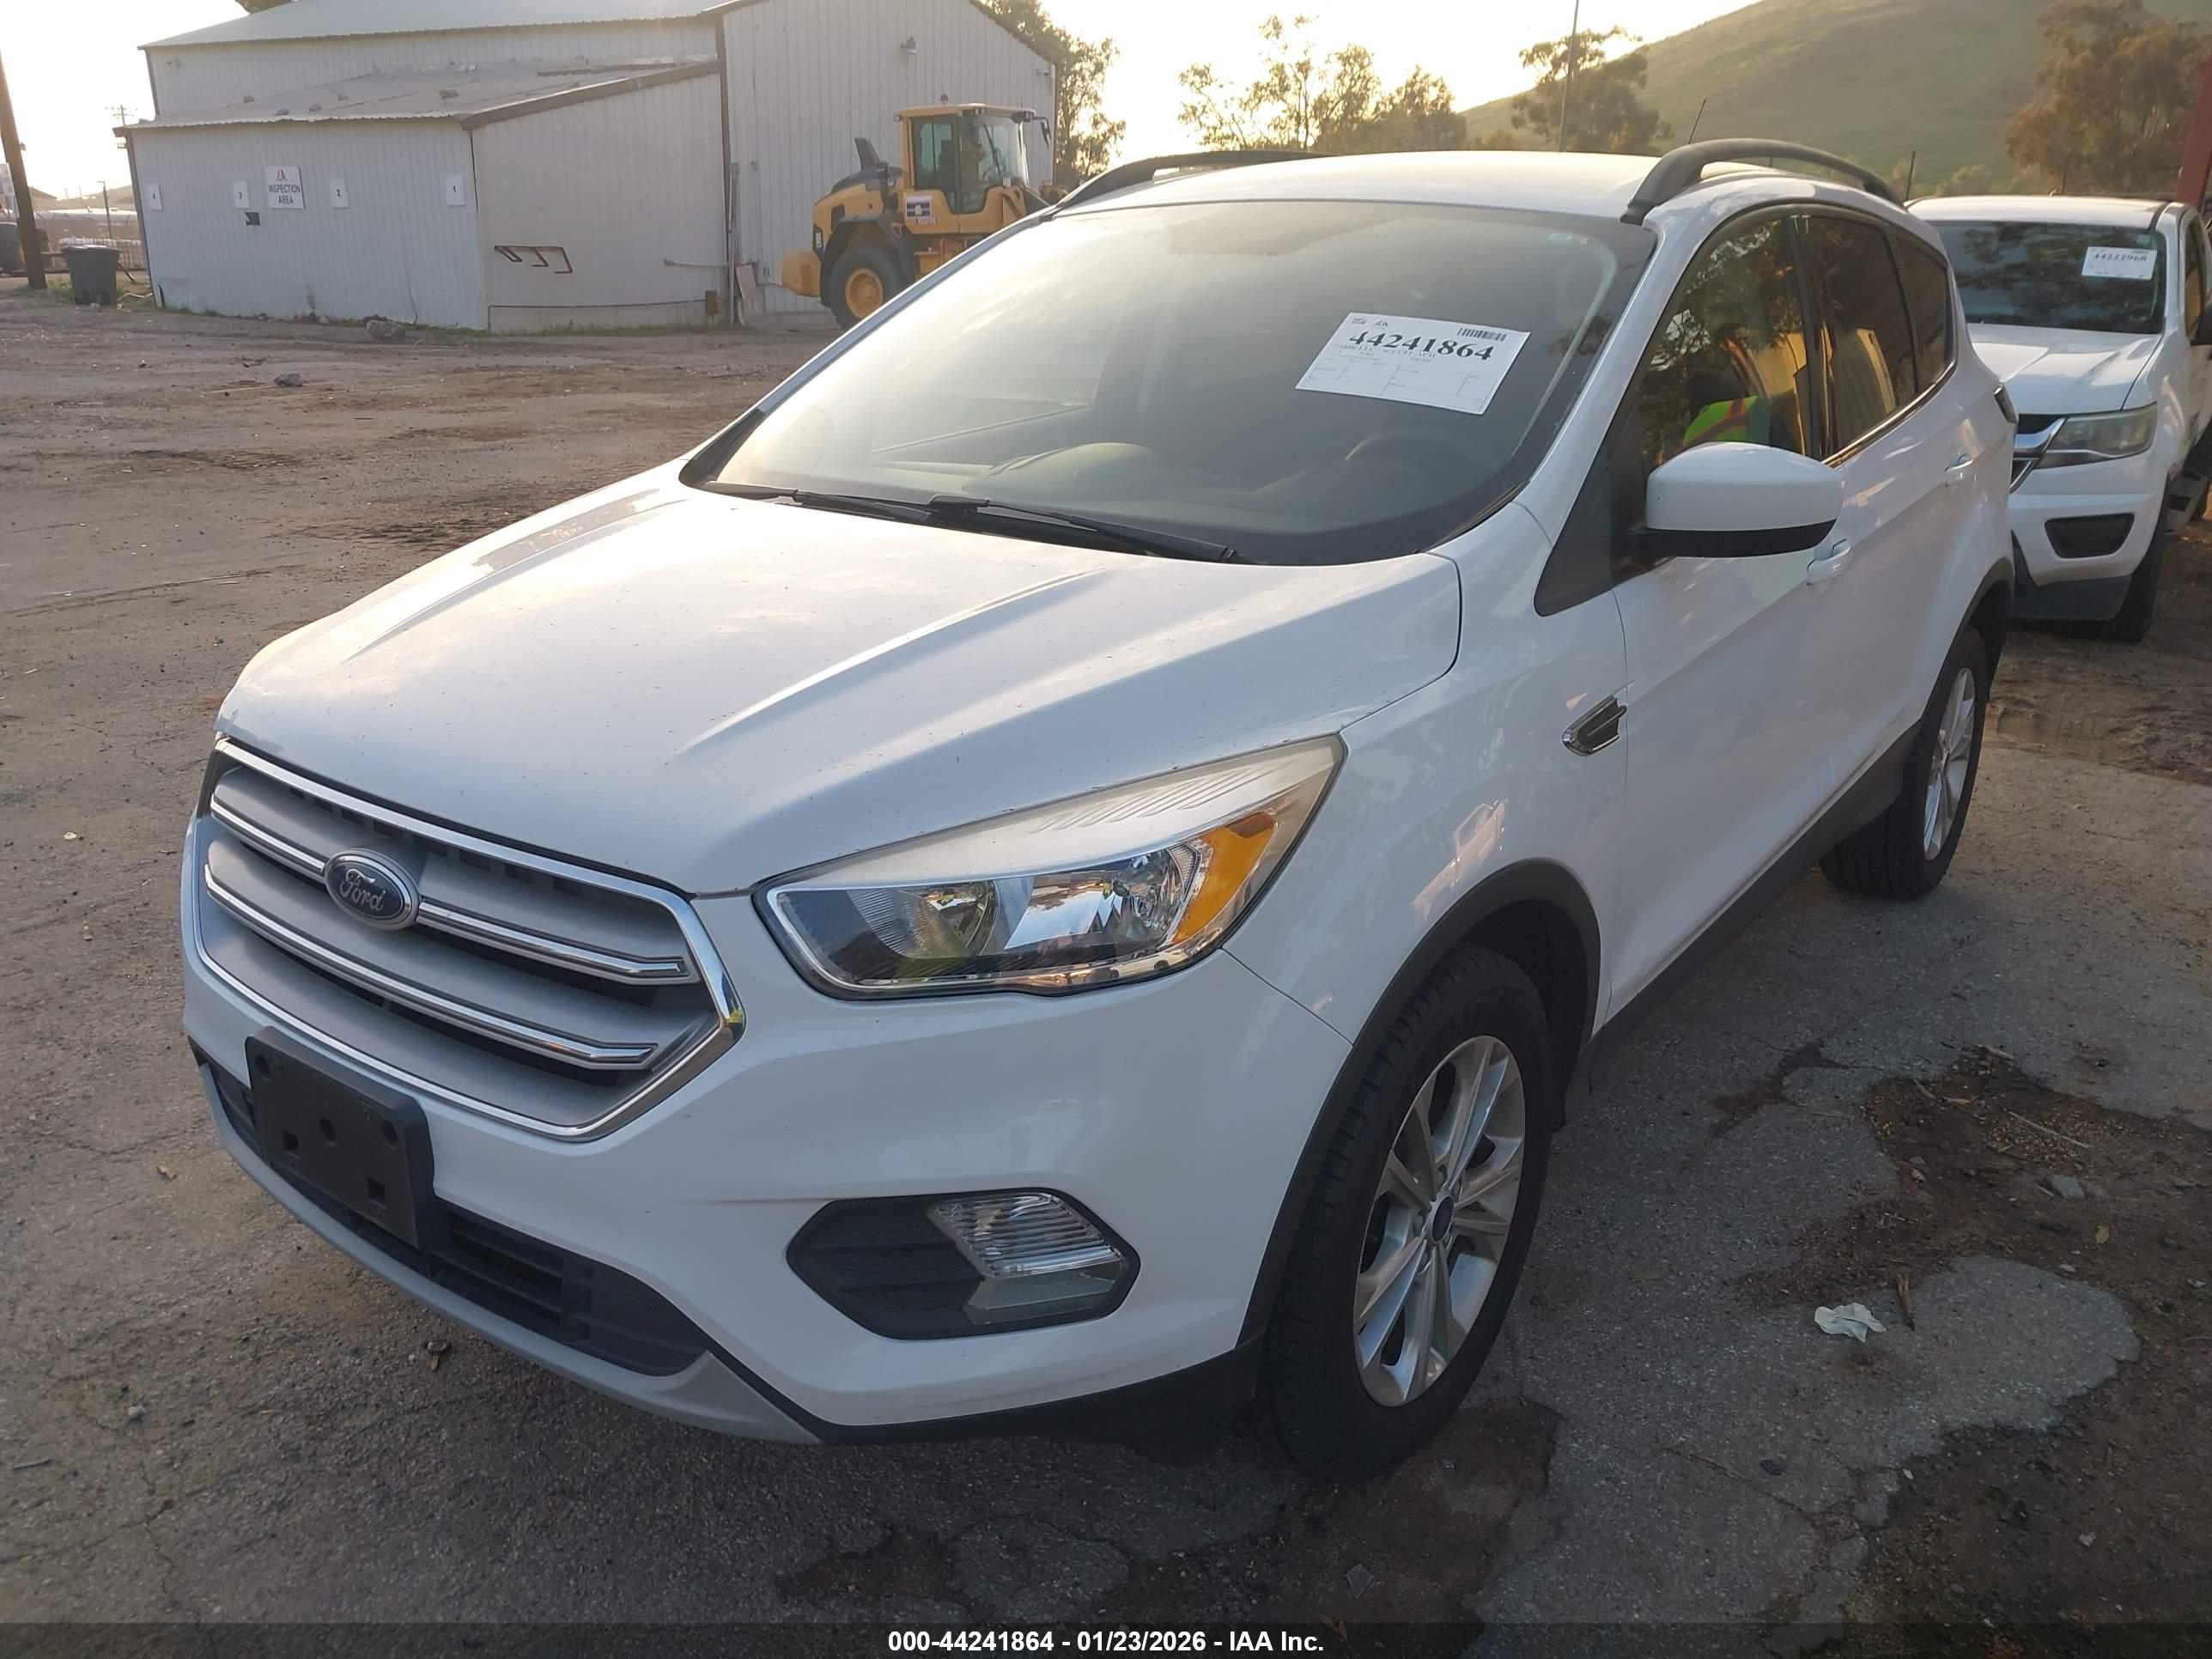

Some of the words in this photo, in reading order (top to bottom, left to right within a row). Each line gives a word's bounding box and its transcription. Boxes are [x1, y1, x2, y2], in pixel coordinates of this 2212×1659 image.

[268, 184, 301, 193] INSPECTION
[278, 195, 294, 204] AREA
[1348, 331, 1495, 362] 44241864
[340, 868, 386, 912] Ford
